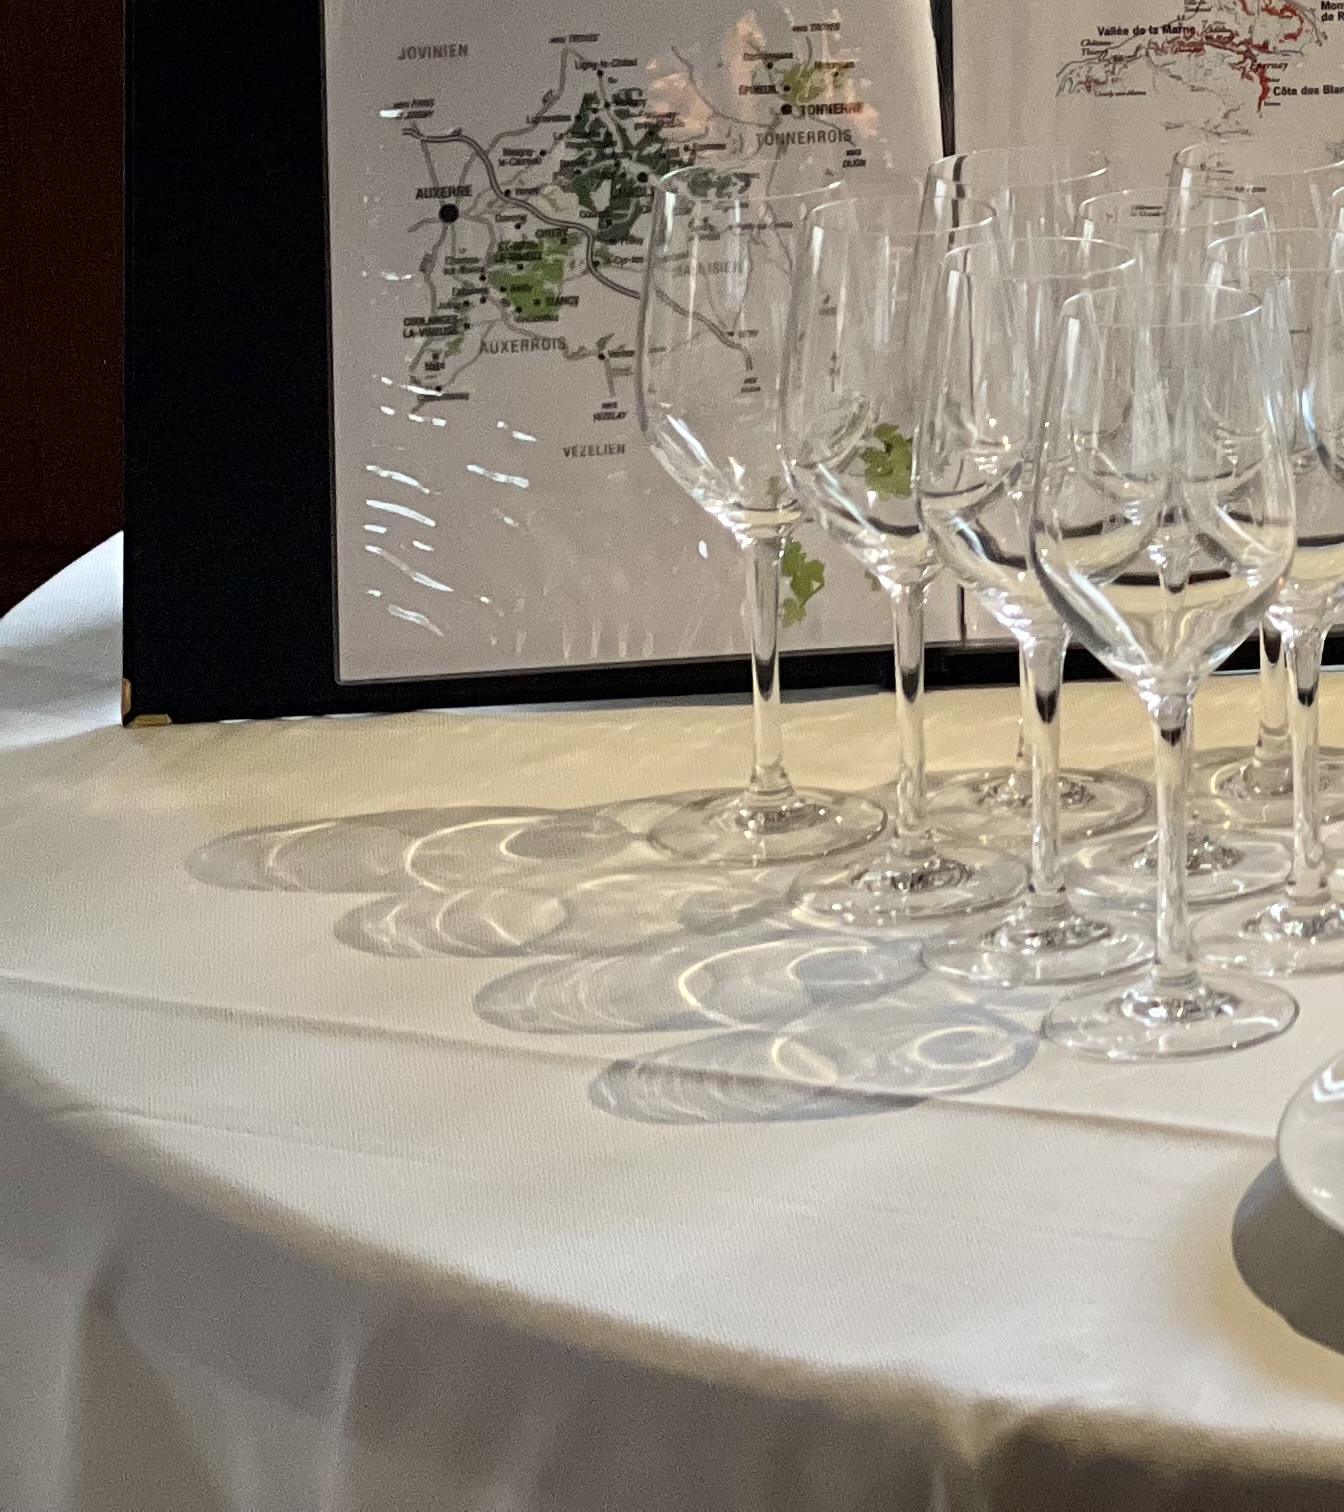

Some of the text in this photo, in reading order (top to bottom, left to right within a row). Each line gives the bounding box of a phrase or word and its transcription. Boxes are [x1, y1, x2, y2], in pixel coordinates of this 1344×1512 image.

[1320, 12, 1335, 22] de
[1096, 25, 1129, 37] Vallée
[1132, 25, 1146, 36] de
[1148, 25, 1159, 35] la
[397, 43, 469, 60] JOVINIEN
[1273, 84, 1298, 96] Côte
[1300, 85, 1319, 95] des
